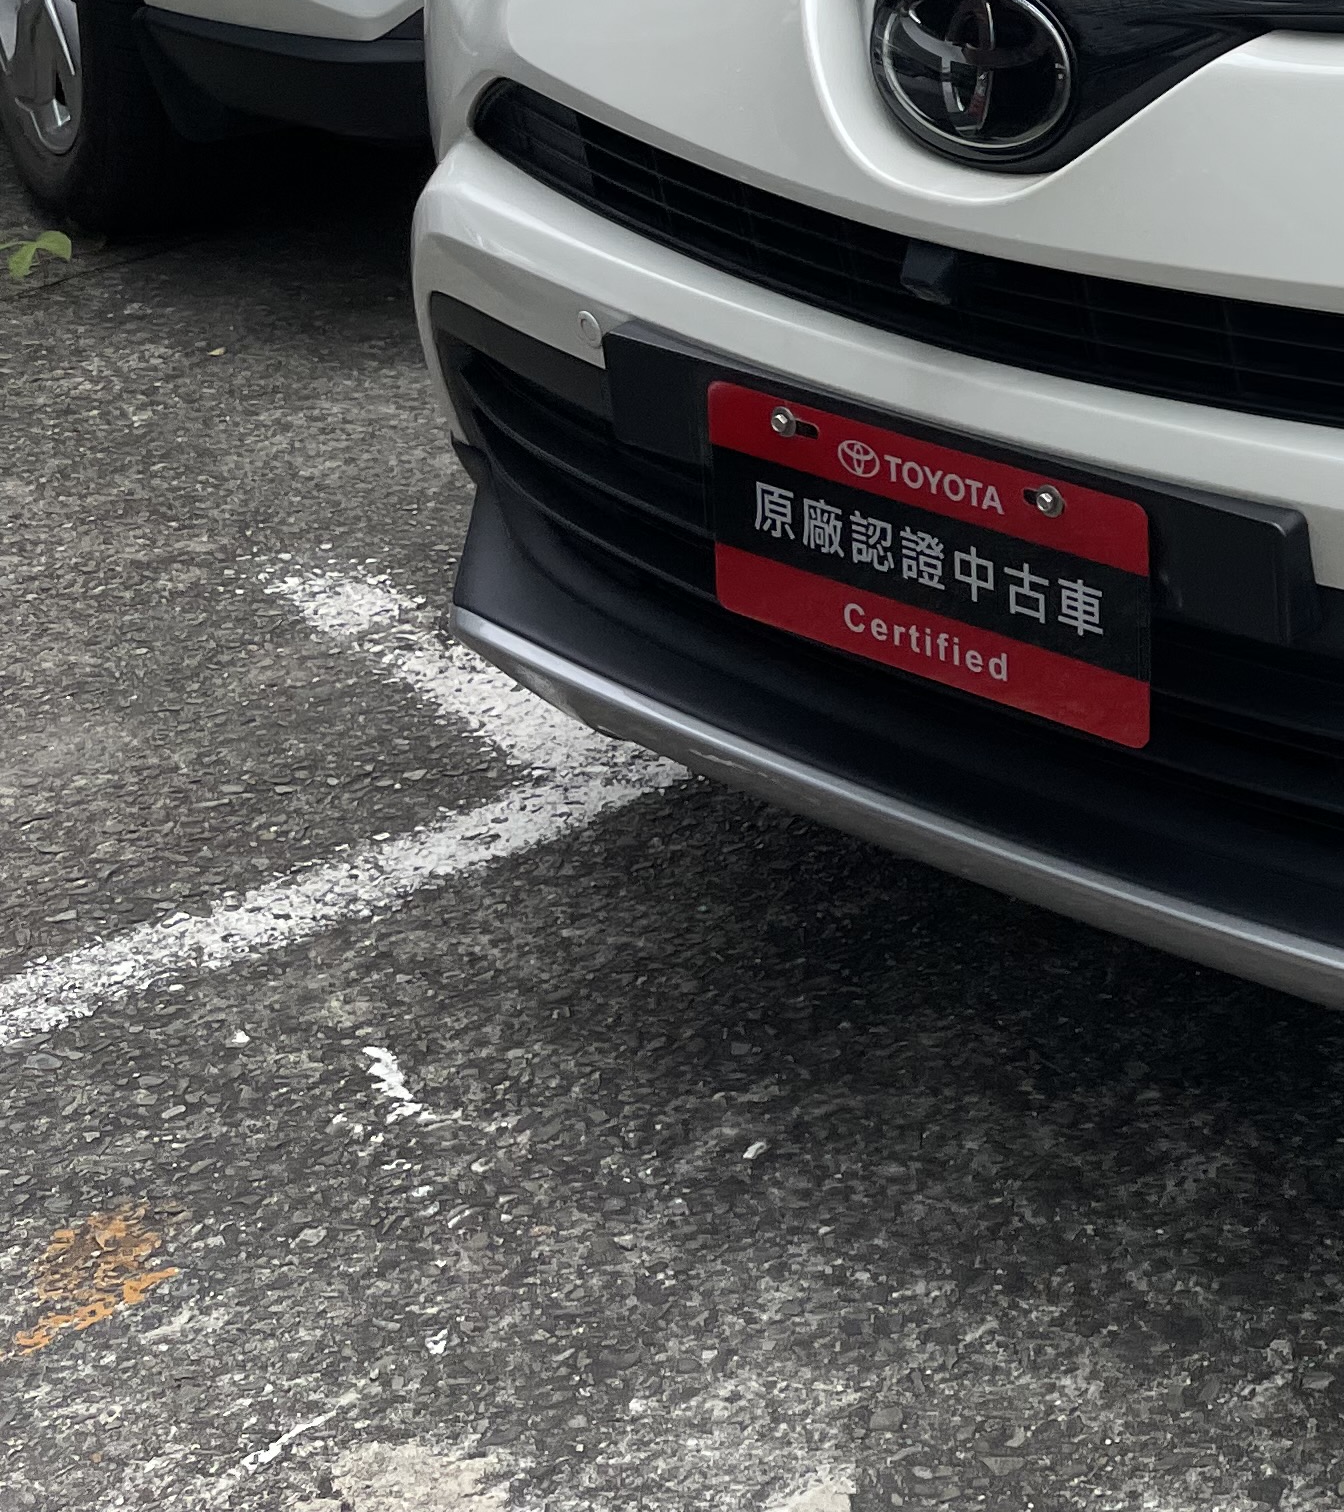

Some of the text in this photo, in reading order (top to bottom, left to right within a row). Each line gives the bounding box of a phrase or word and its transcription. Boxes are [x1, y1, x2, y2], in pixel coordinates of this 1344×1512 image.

[883, 453, 1005, 516] TOYOTA
[754, 480, 1105, 638] 原廠認證中古車
[843, 602, 1009, 682] Certified
